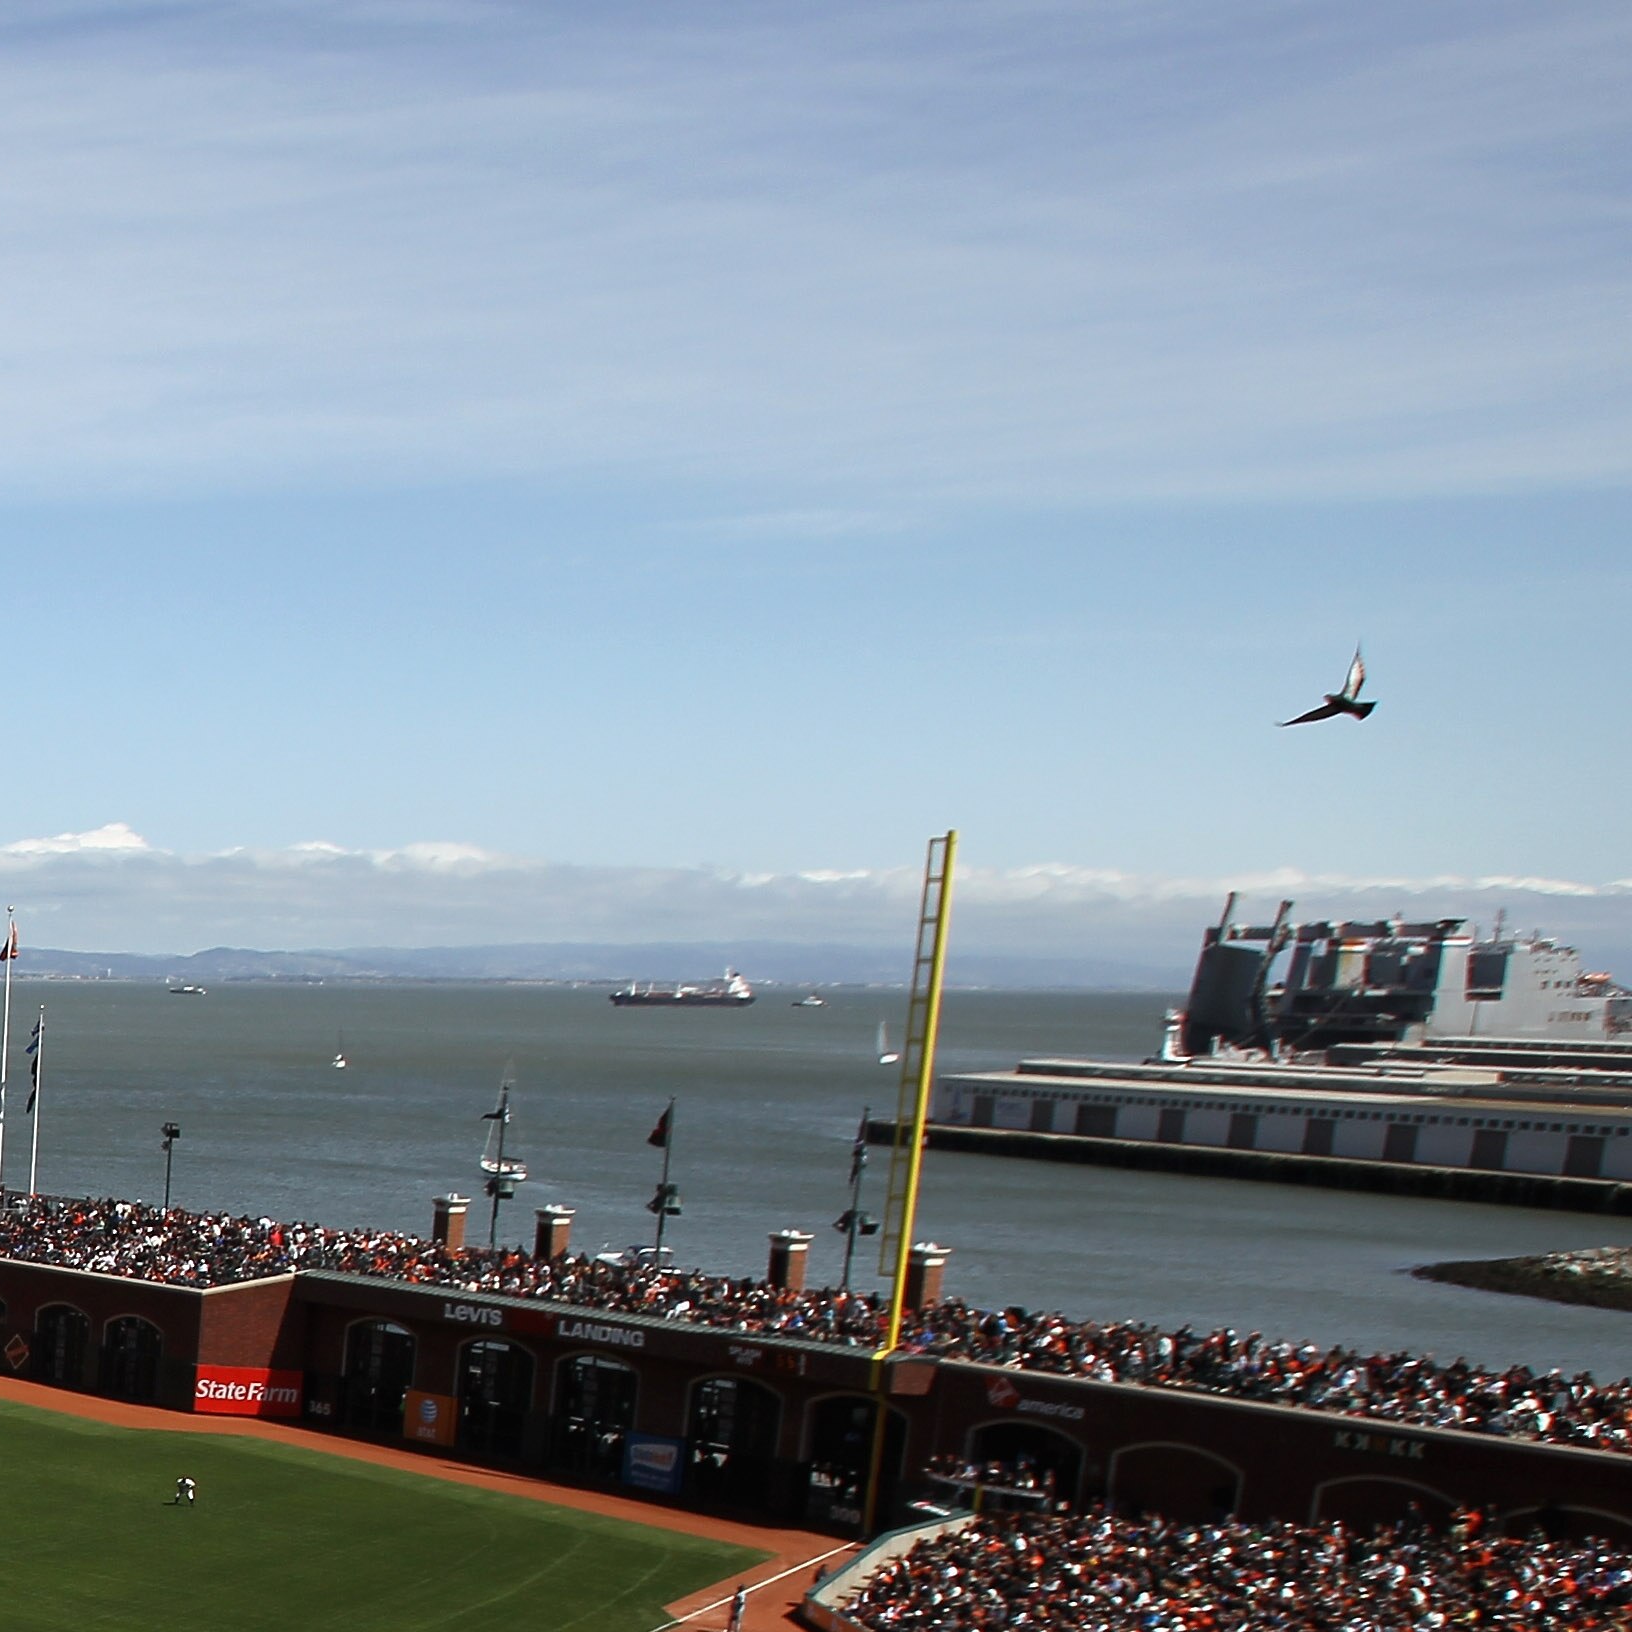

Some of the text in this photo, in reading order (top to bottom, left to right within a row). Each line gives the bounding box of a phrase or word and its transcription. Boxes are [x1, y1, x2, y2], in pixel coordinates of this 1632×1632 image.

[558, 1320, 646, 1348] LANDING
[308, 1400, 332, 1415] 365
[1017, 1398, 1086, 1420] america
